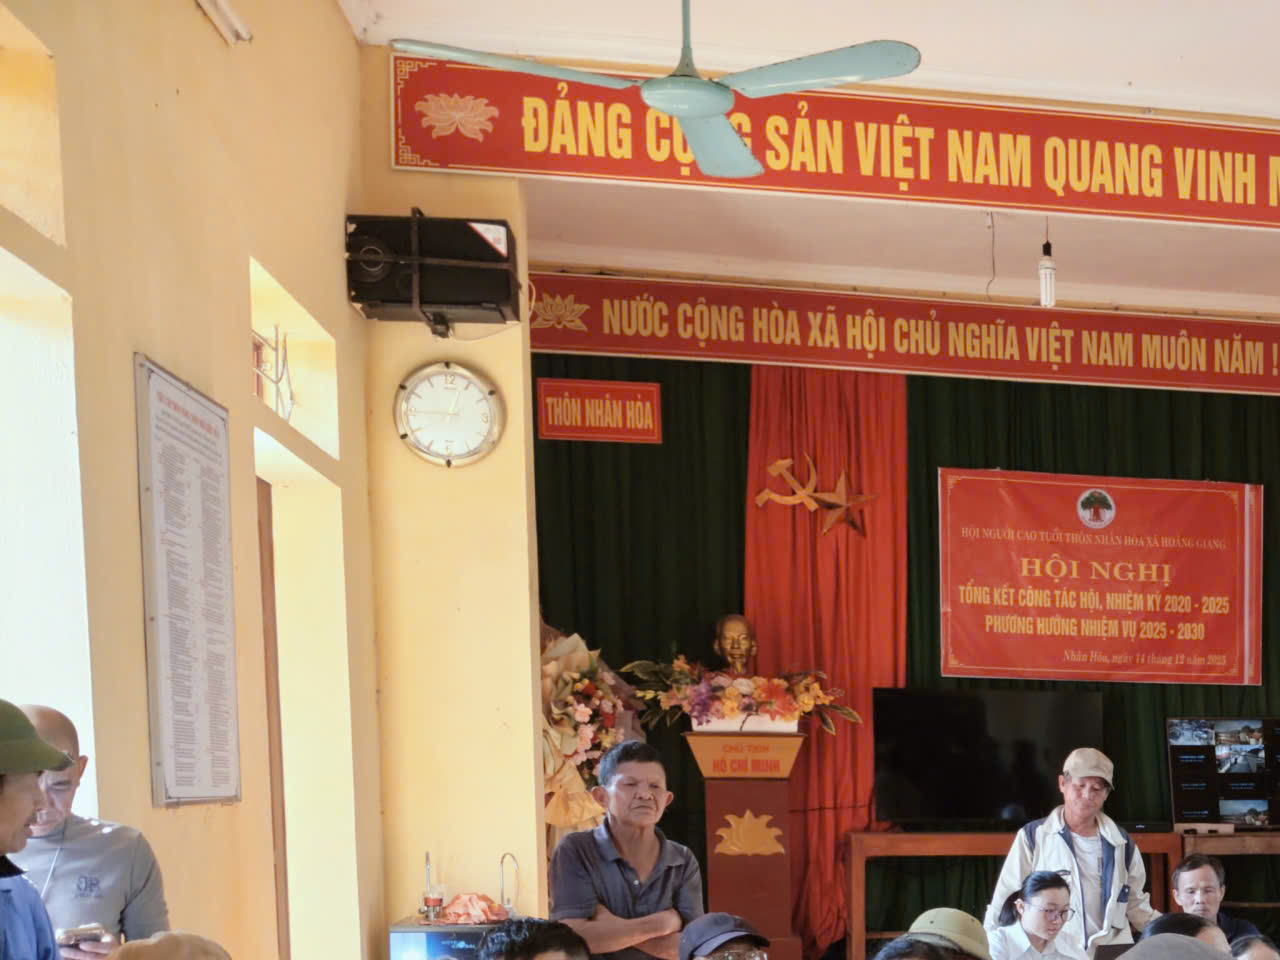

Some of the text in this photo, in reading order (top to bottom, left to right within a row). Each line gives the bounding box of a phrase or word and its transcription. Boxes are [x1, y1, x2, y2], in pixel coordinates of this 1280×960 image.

[521, 81, 633, 160] ĐẢNG
[766, 102, 844, 172] SẢN
[855, 113, 935, 191] VIỆT
[947, 128, 1032, 188] NAM
[1043, 135, 1163, 198] QUANG
[1174, 146, 1257, 204] VINH
[602, 293, 668, 337] NƯỚC
[677, 296, 745, 347] CỘNG
[753, 300, 801, 346] HÒA
[807, 305, 841, 348] XÃ
[846, 308, 886, 359] HỘI
[893, 309, 941, 356] CHỦ
[947, 318, 1021, 361] NGHĨA
[1025, 321, 1074, 371] VIỆT
[1081, 329, 1134, 368] NAM
[1141, 329, 1207, 372] MUÔN
[1213, 333, 1265, 375] NĂM
[545, 391, 653, 429] THÔN NHÂN HÒA
[1017, 530, 1037, 541] CAO
[1020, 553, 1172, 587] HỘI NGHỊ
[959, 578, 991, 605] TỔNG
[993, 582, 1016, 606] KẾT
[1018, 585, 1051, 608] CÔNG
[1054, 587, 1076, 609] TÁC
[1106, 590, 1144, 615] NHIỆM
[1164, 595, 1192, 613] 2020
[1201, 596, 1230, 614] 2025
[985, 614, 1034, 634] PHƯƠNG
[1080, 615, 1119, 640] NHIỆM
[1122, 619, 1137, 642] VỤ
[1140, 621, 1167, 640] 2025
[1177, 622, 1205, 640] 2030
